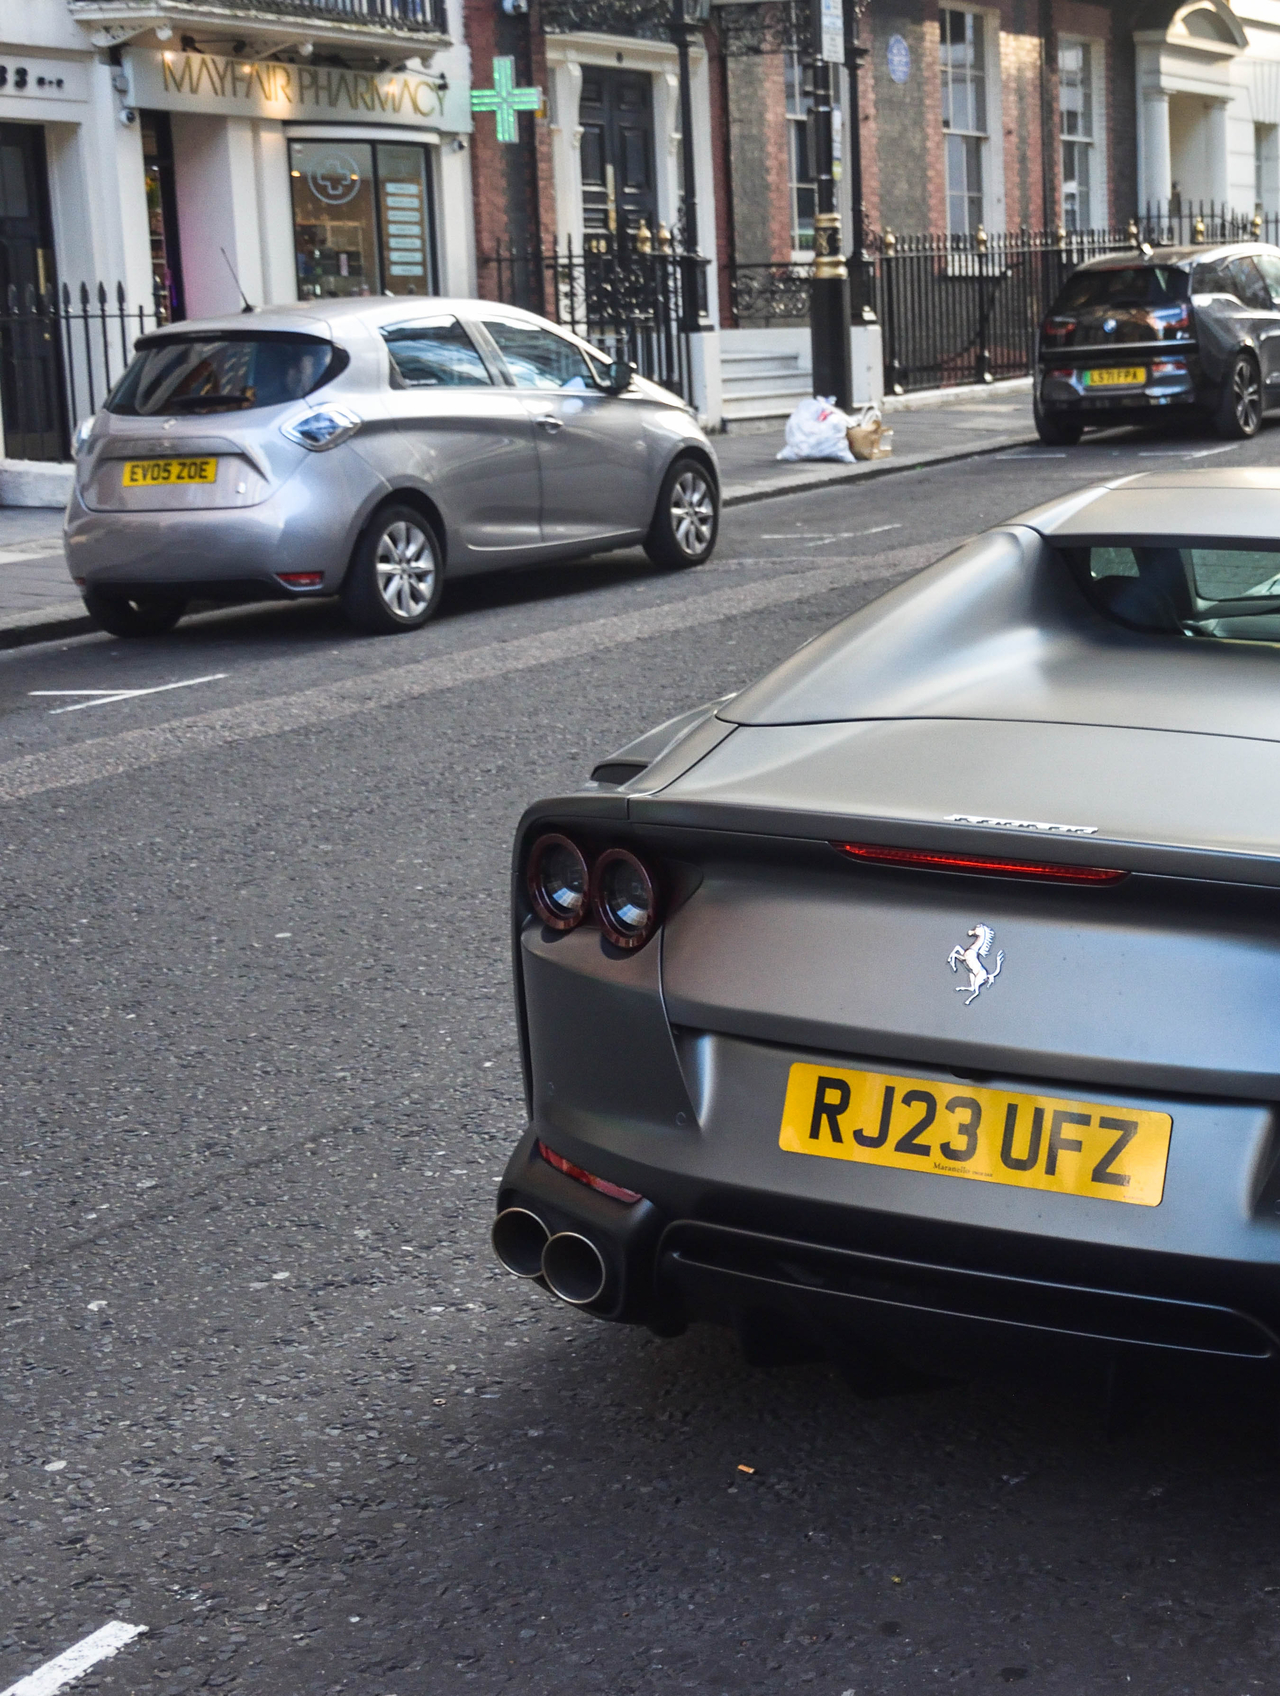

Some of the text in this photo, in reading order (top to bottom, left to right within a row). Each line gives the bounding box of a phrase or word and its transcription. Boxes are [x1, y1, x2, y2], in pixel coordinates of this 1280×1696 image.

[161, 52, 447, 117] MAYFAIR PHARMACY
[129, 461, 210, 482] EV05 ZOE
[807, 1075, 1139, 1187] RJ23 UFZ
[933, 1161, 970, 1175] Maranello
